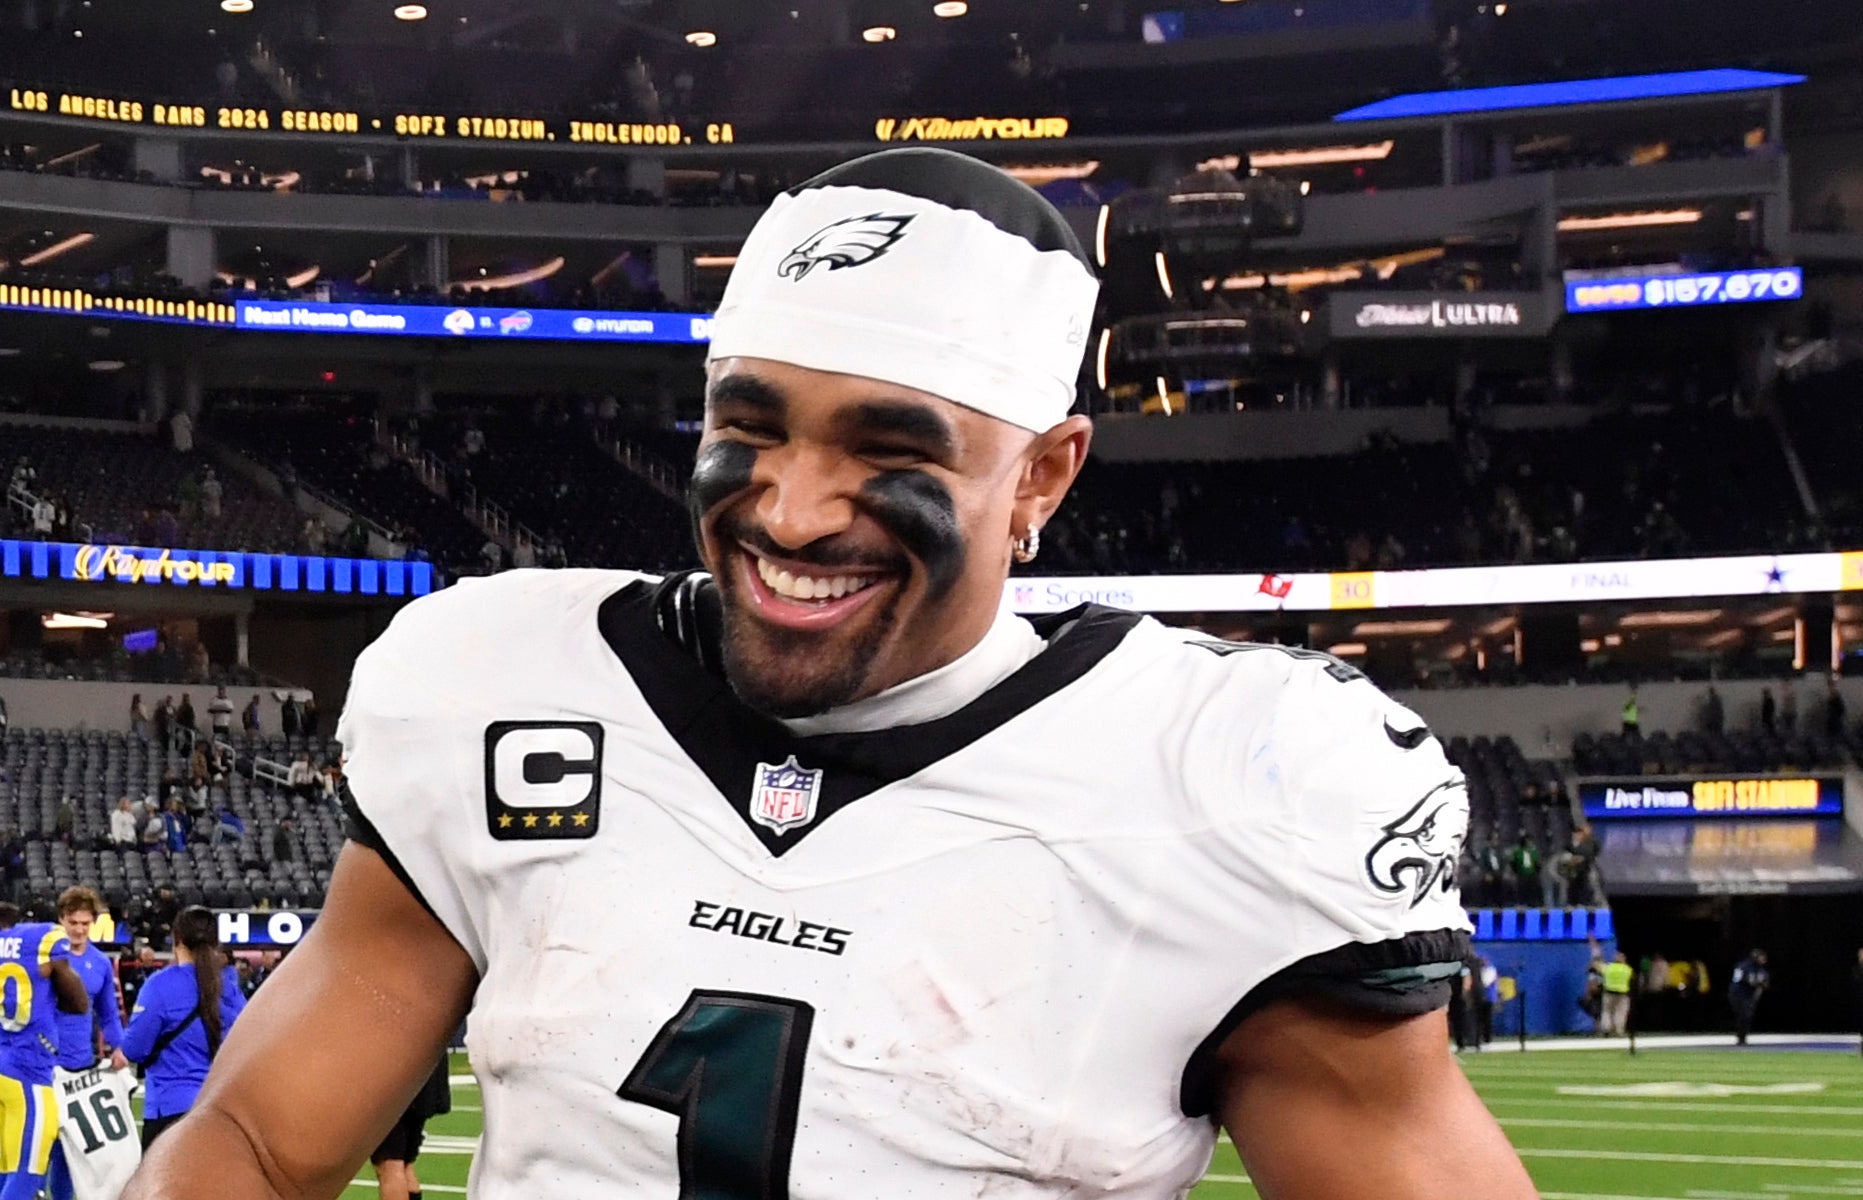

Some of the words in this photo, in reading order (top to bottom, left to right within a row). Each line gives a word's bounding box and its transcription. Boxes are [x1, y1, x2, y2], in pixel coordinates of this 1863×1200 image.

[11, 89, 48, 111] LOS
[59, 94, 143, 122] ANGELES
[153, 104, 205, 127] RAMS
[218, 108, 269, 129] 2024
[282, 110, 358, 132] SEASON
[395, 115, 446, 136] SOFI
[706, 124, 733, 144] CA
[1446, 302, 1520, 326] ULTRA
[1045, 582, 1134, 606] Scores
[1571, 572, 1633, 588] FINAL
[494, 728, 595, 808] C
[762, 790, 805, 820] NFL
[688, 900, 854, 957] EAGLES
[67, 1088, 129, 1155] 16
